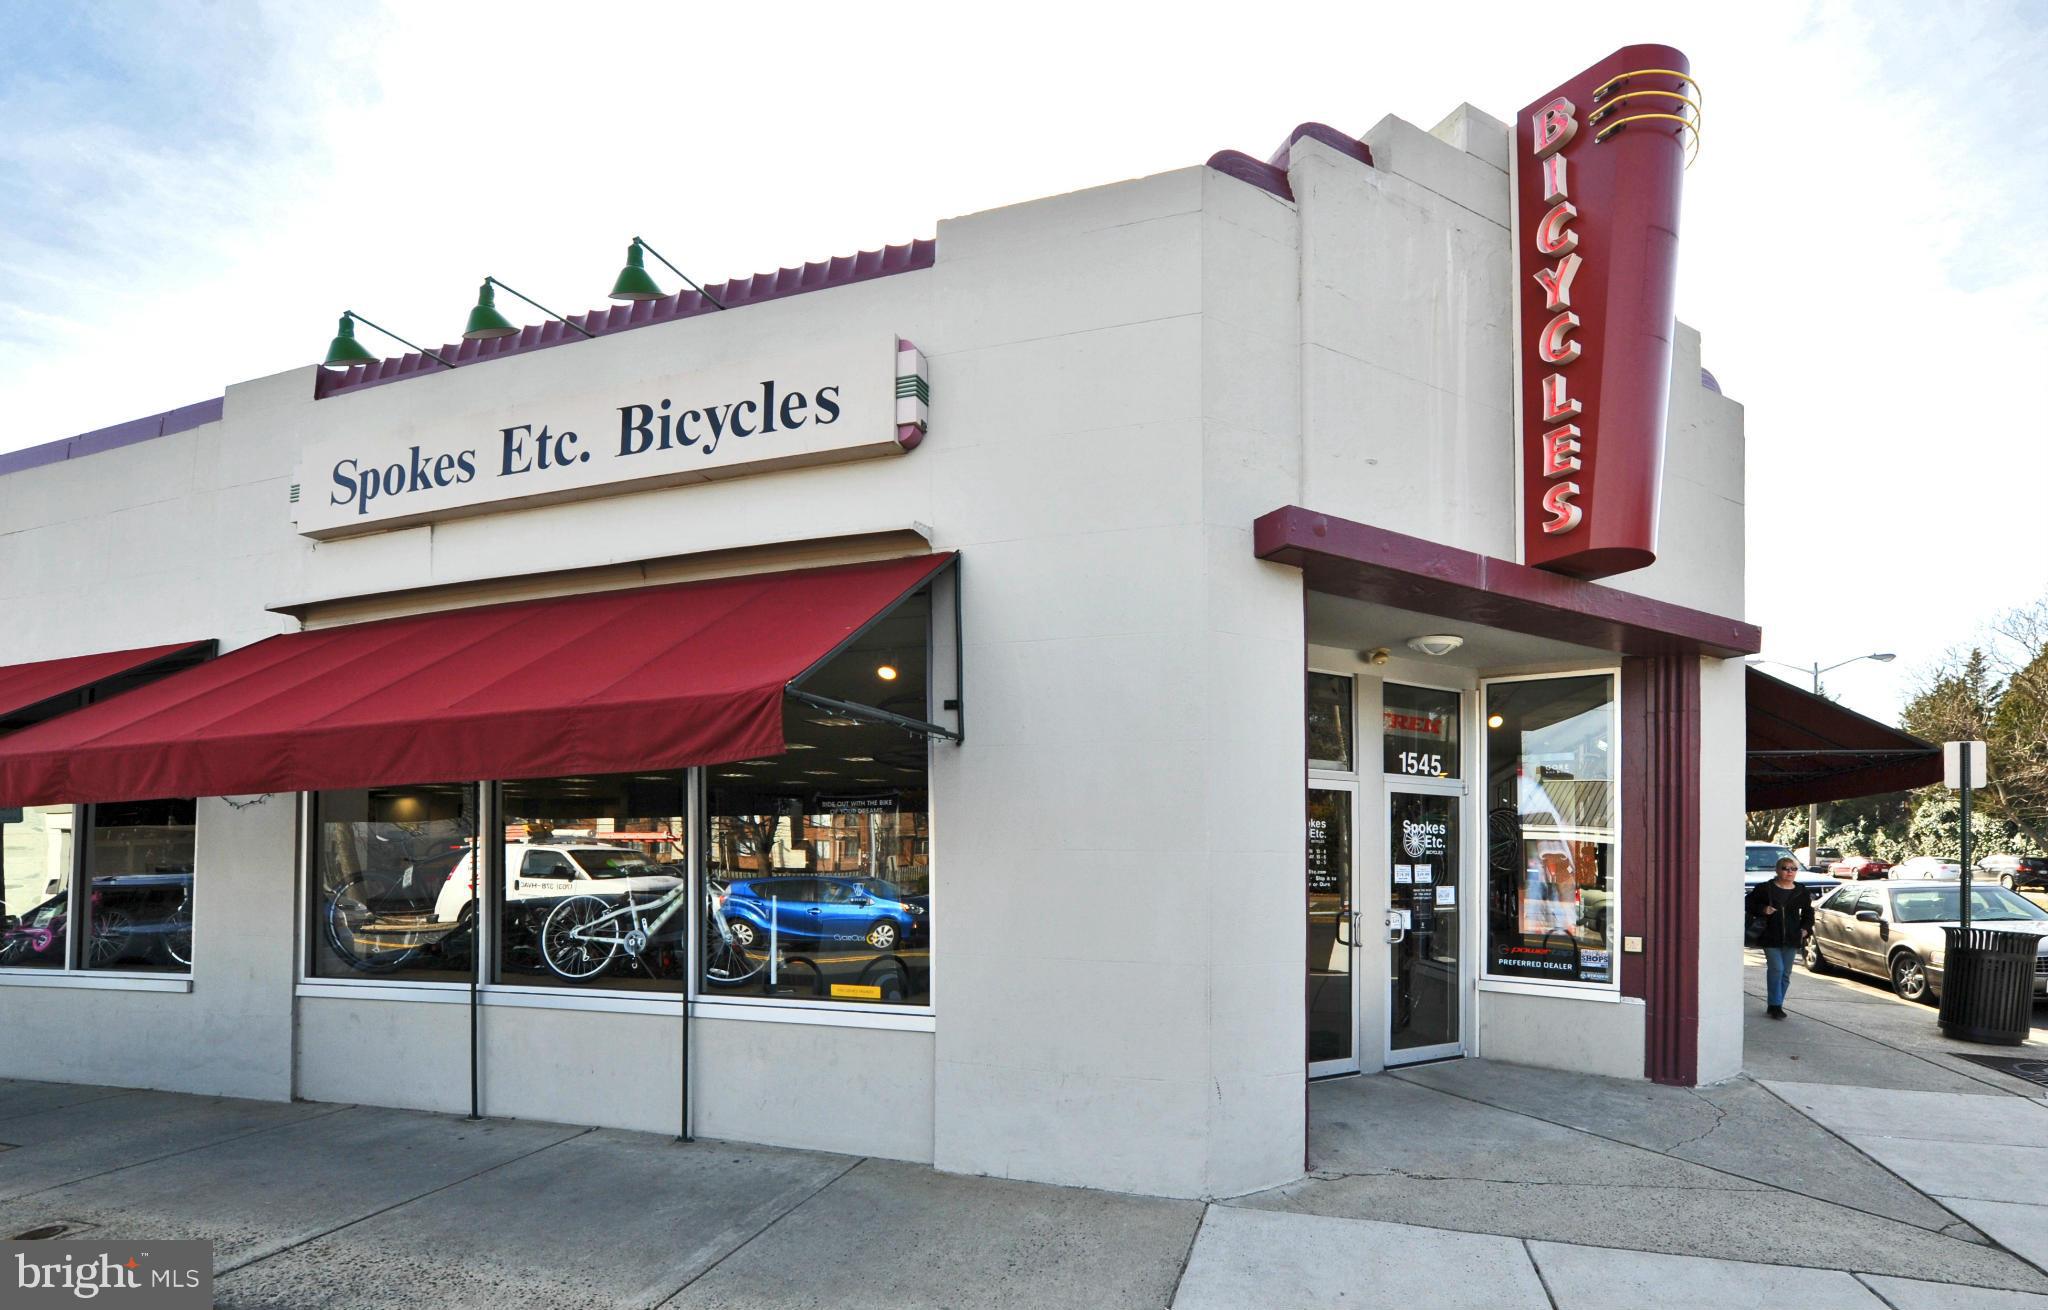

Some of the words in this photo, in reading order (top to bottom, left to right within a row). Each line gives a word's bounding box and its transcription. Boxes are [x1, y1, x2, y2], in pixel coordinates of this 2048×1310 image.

[1533, 96, 1582, 535] BICYCLES
[330, 445, 476, 514] Spokes
[497, 424, 591, 477] Etc.
[615, 381, 841, 457] Bicycles
[1399, 752, 1441, 776] 1545
[1310, 829, 1327, 839] Etc.
[1403, 820, 1446, 836] Spokes
[1425, 835, 1446, 848] Etc.
[1498, 959, 1541, 968] PREFERRED
[1543, 962, 1573, 970] DEALER
[1581, 955, 1609, 963] SHOPS
